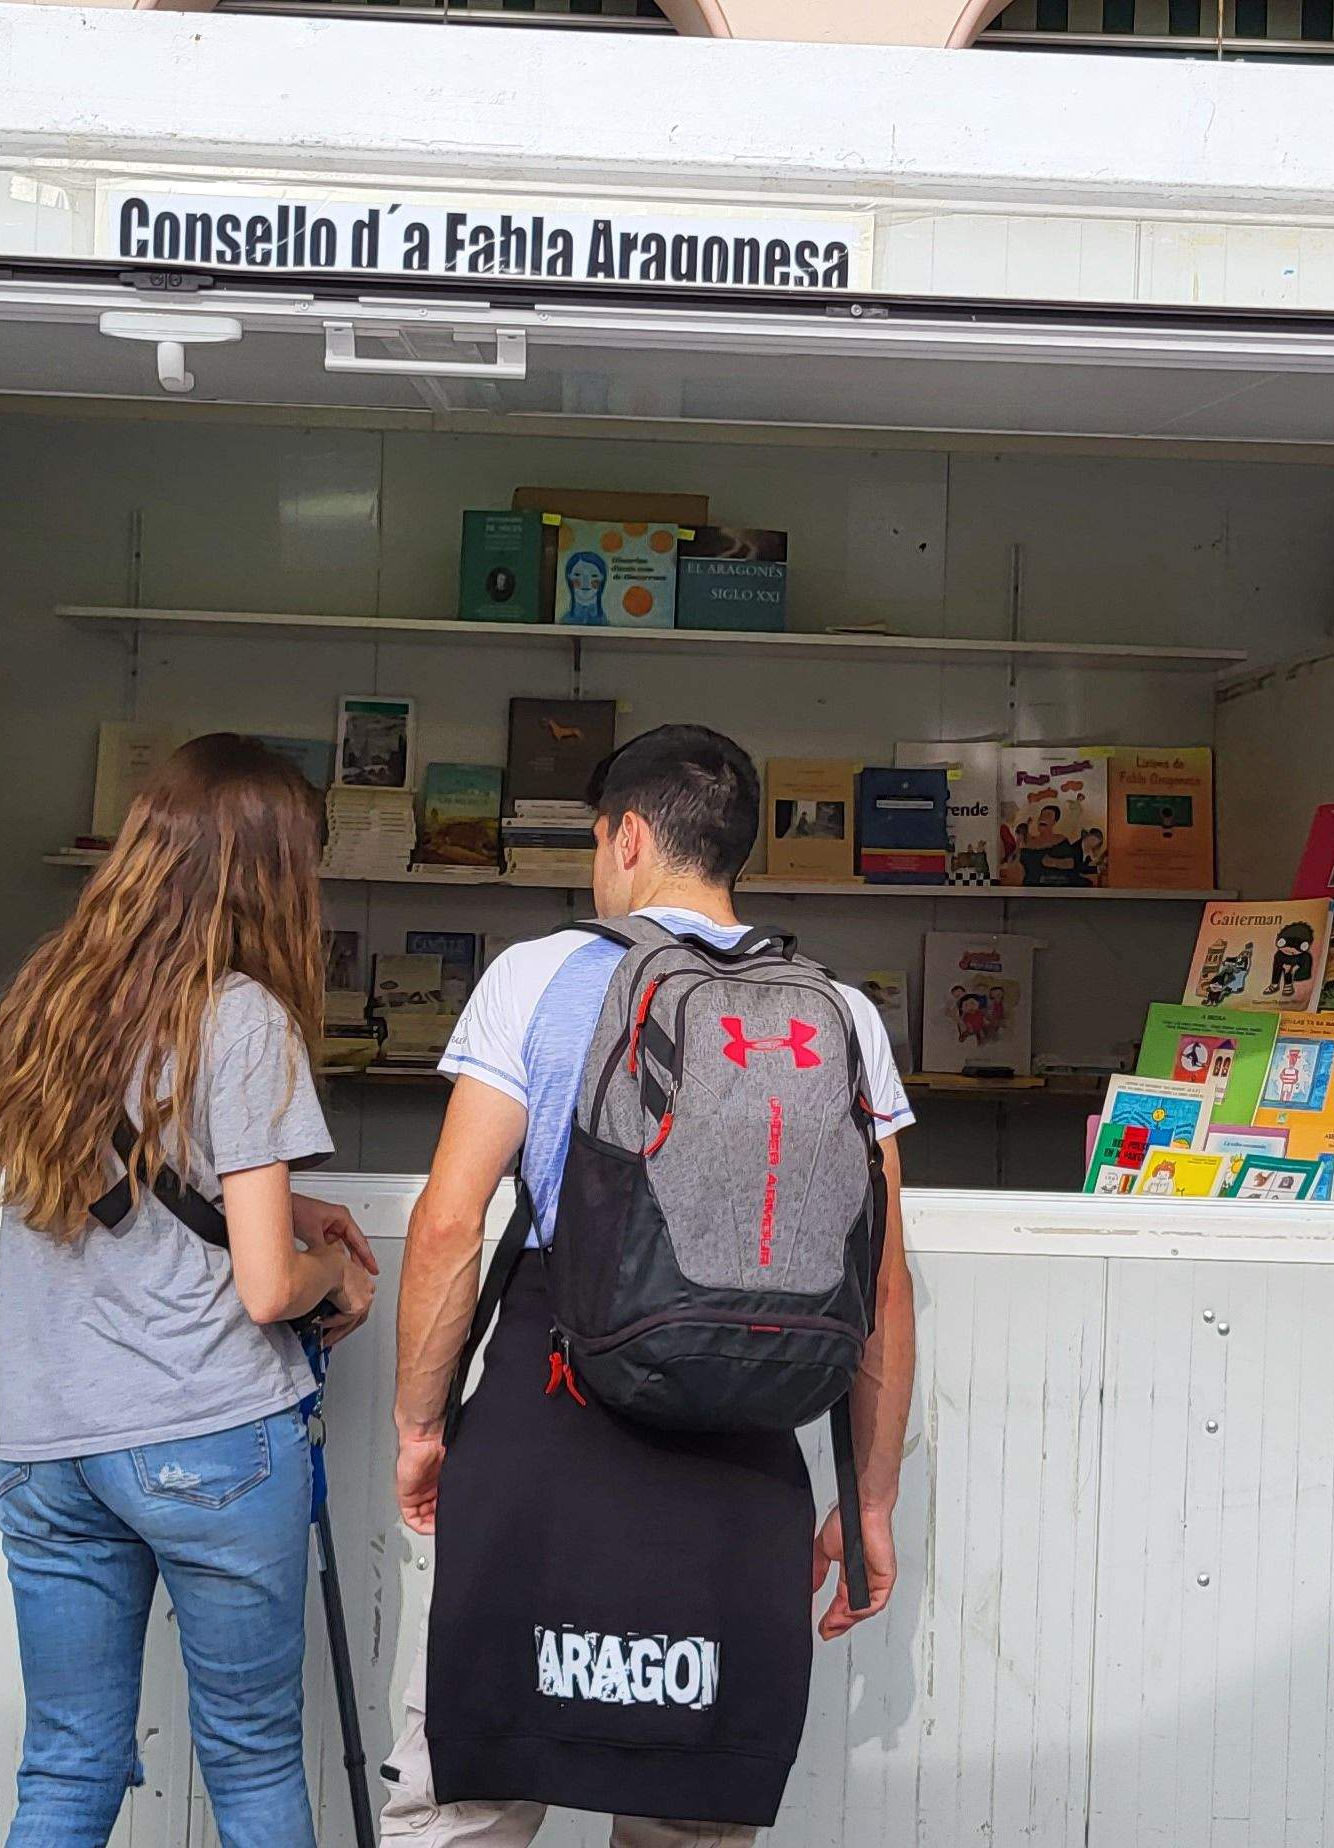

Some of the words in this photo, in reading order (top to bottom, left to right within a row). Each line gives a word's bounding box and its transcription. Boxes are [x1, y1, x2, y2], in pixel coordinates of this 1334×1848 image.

[119, 197, 338, 267] Consello
[444, 212, 574, 277] Fabla
[586, 219, 849, 289] Aragonesa
[709, 588, 753, 601] SIGLO
[1209, 910, 1283, 926] Gaiterman
